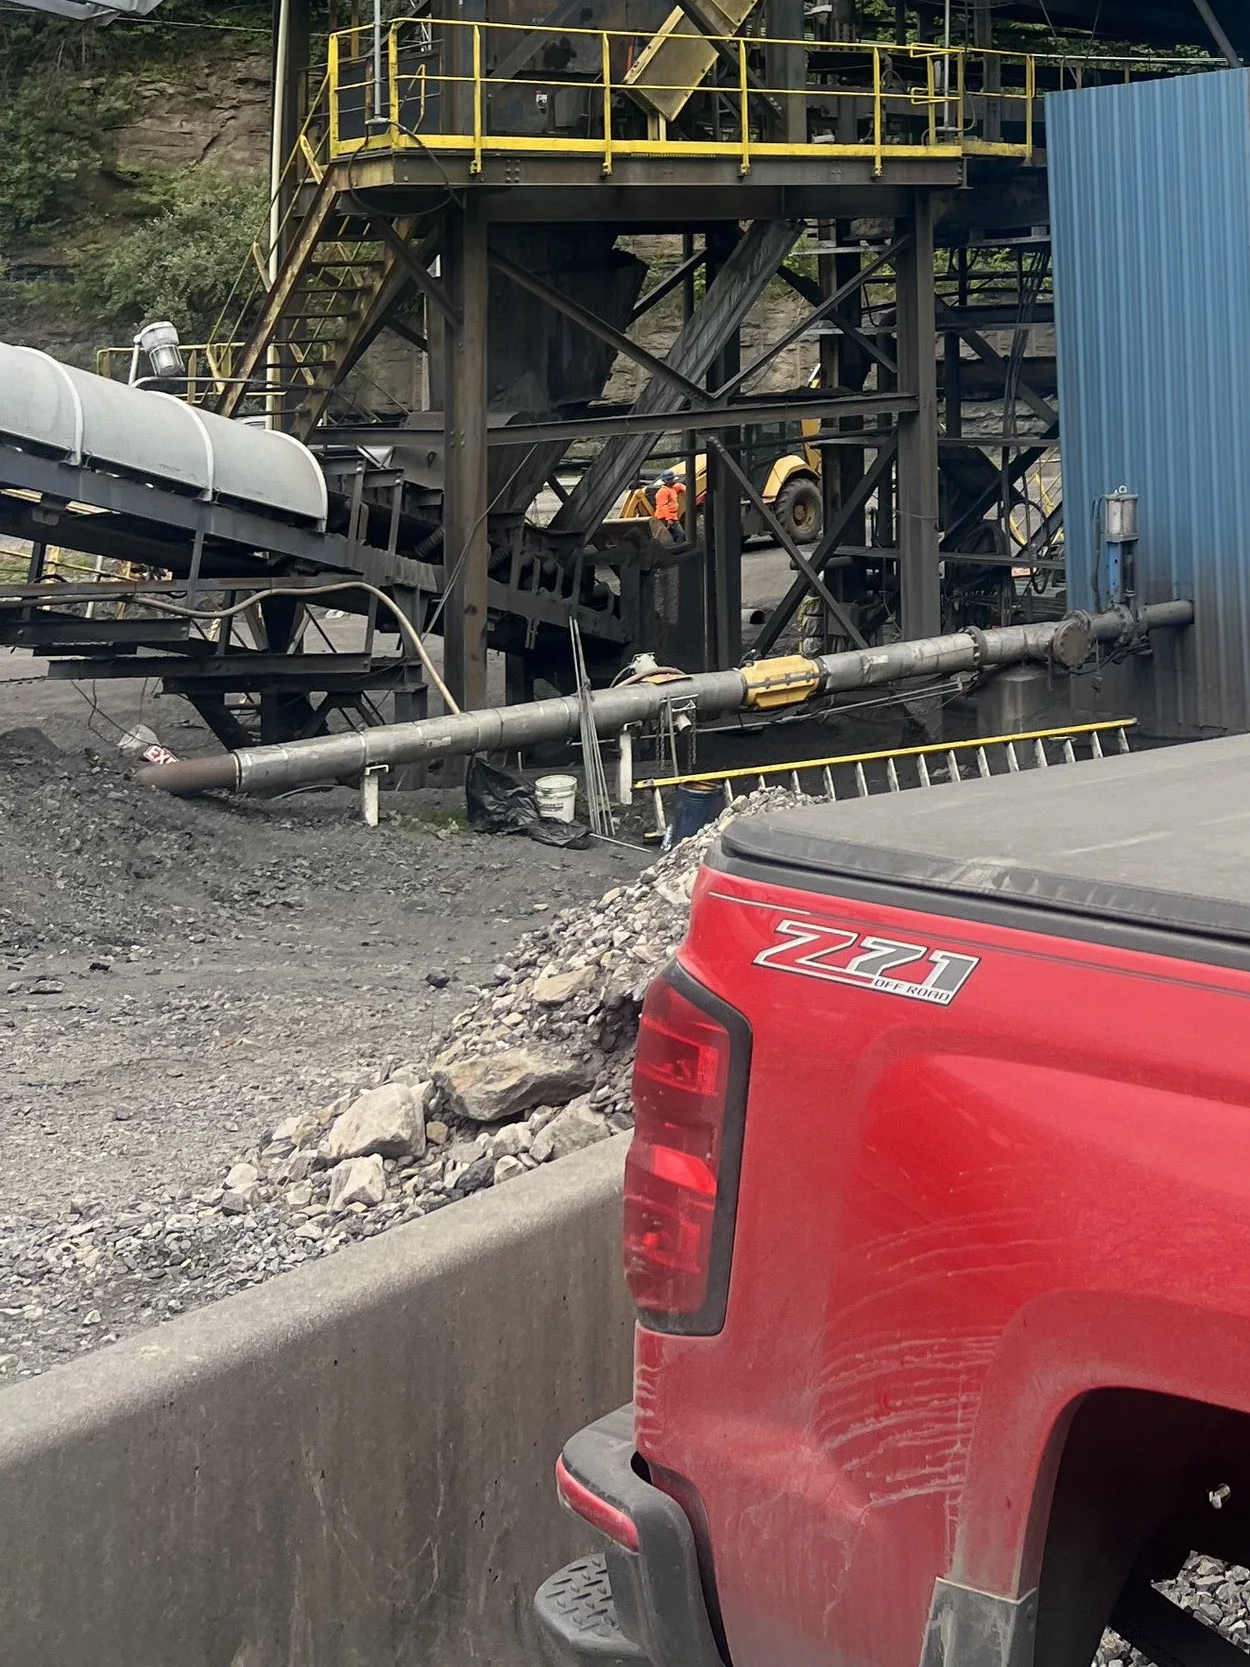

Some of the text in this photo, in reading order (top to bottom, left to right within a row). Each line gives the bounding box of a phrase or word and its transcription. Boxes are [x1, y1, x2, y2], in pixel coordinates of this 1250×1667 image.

[753, 919, 980, 1001] Z71
[874, 978, 950, 1002] OFF ROAD
